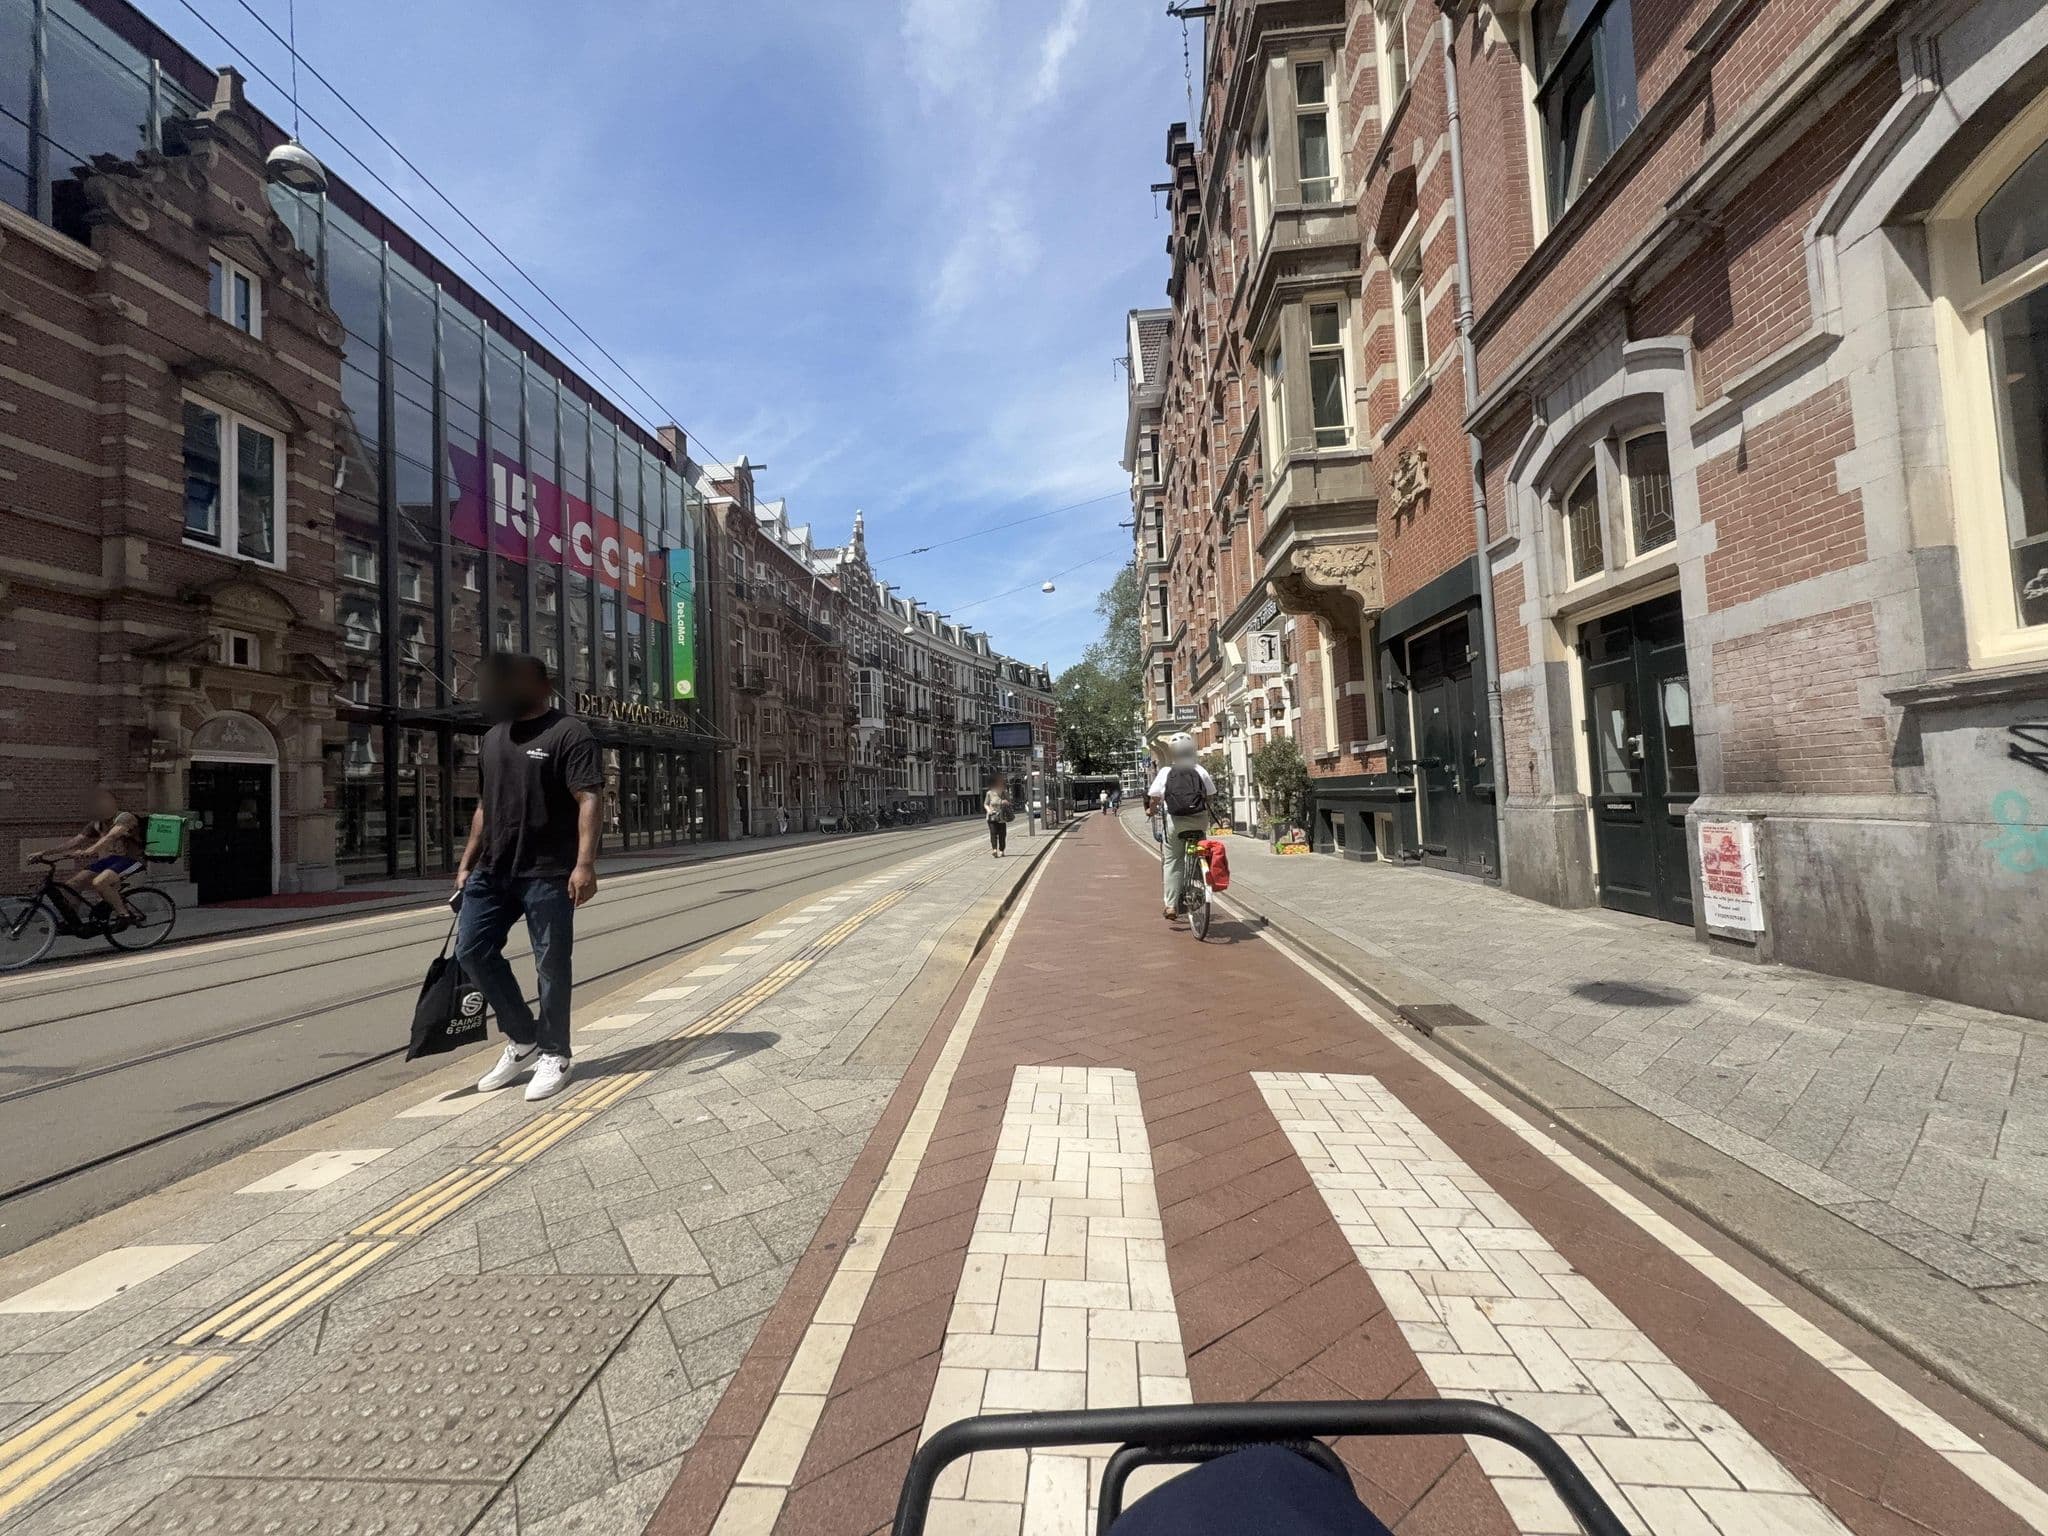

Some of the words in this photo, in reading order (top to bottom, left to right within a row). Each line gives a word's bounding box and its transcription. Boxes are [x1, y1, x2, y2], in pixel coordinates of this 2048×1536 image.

[492, 462, 541, 538] 15
[677, 602, 685, 646] DeLaMar
[450, 1014, 483, 1027] SAINTS
[454, 1021, 483, 1034] STARS
